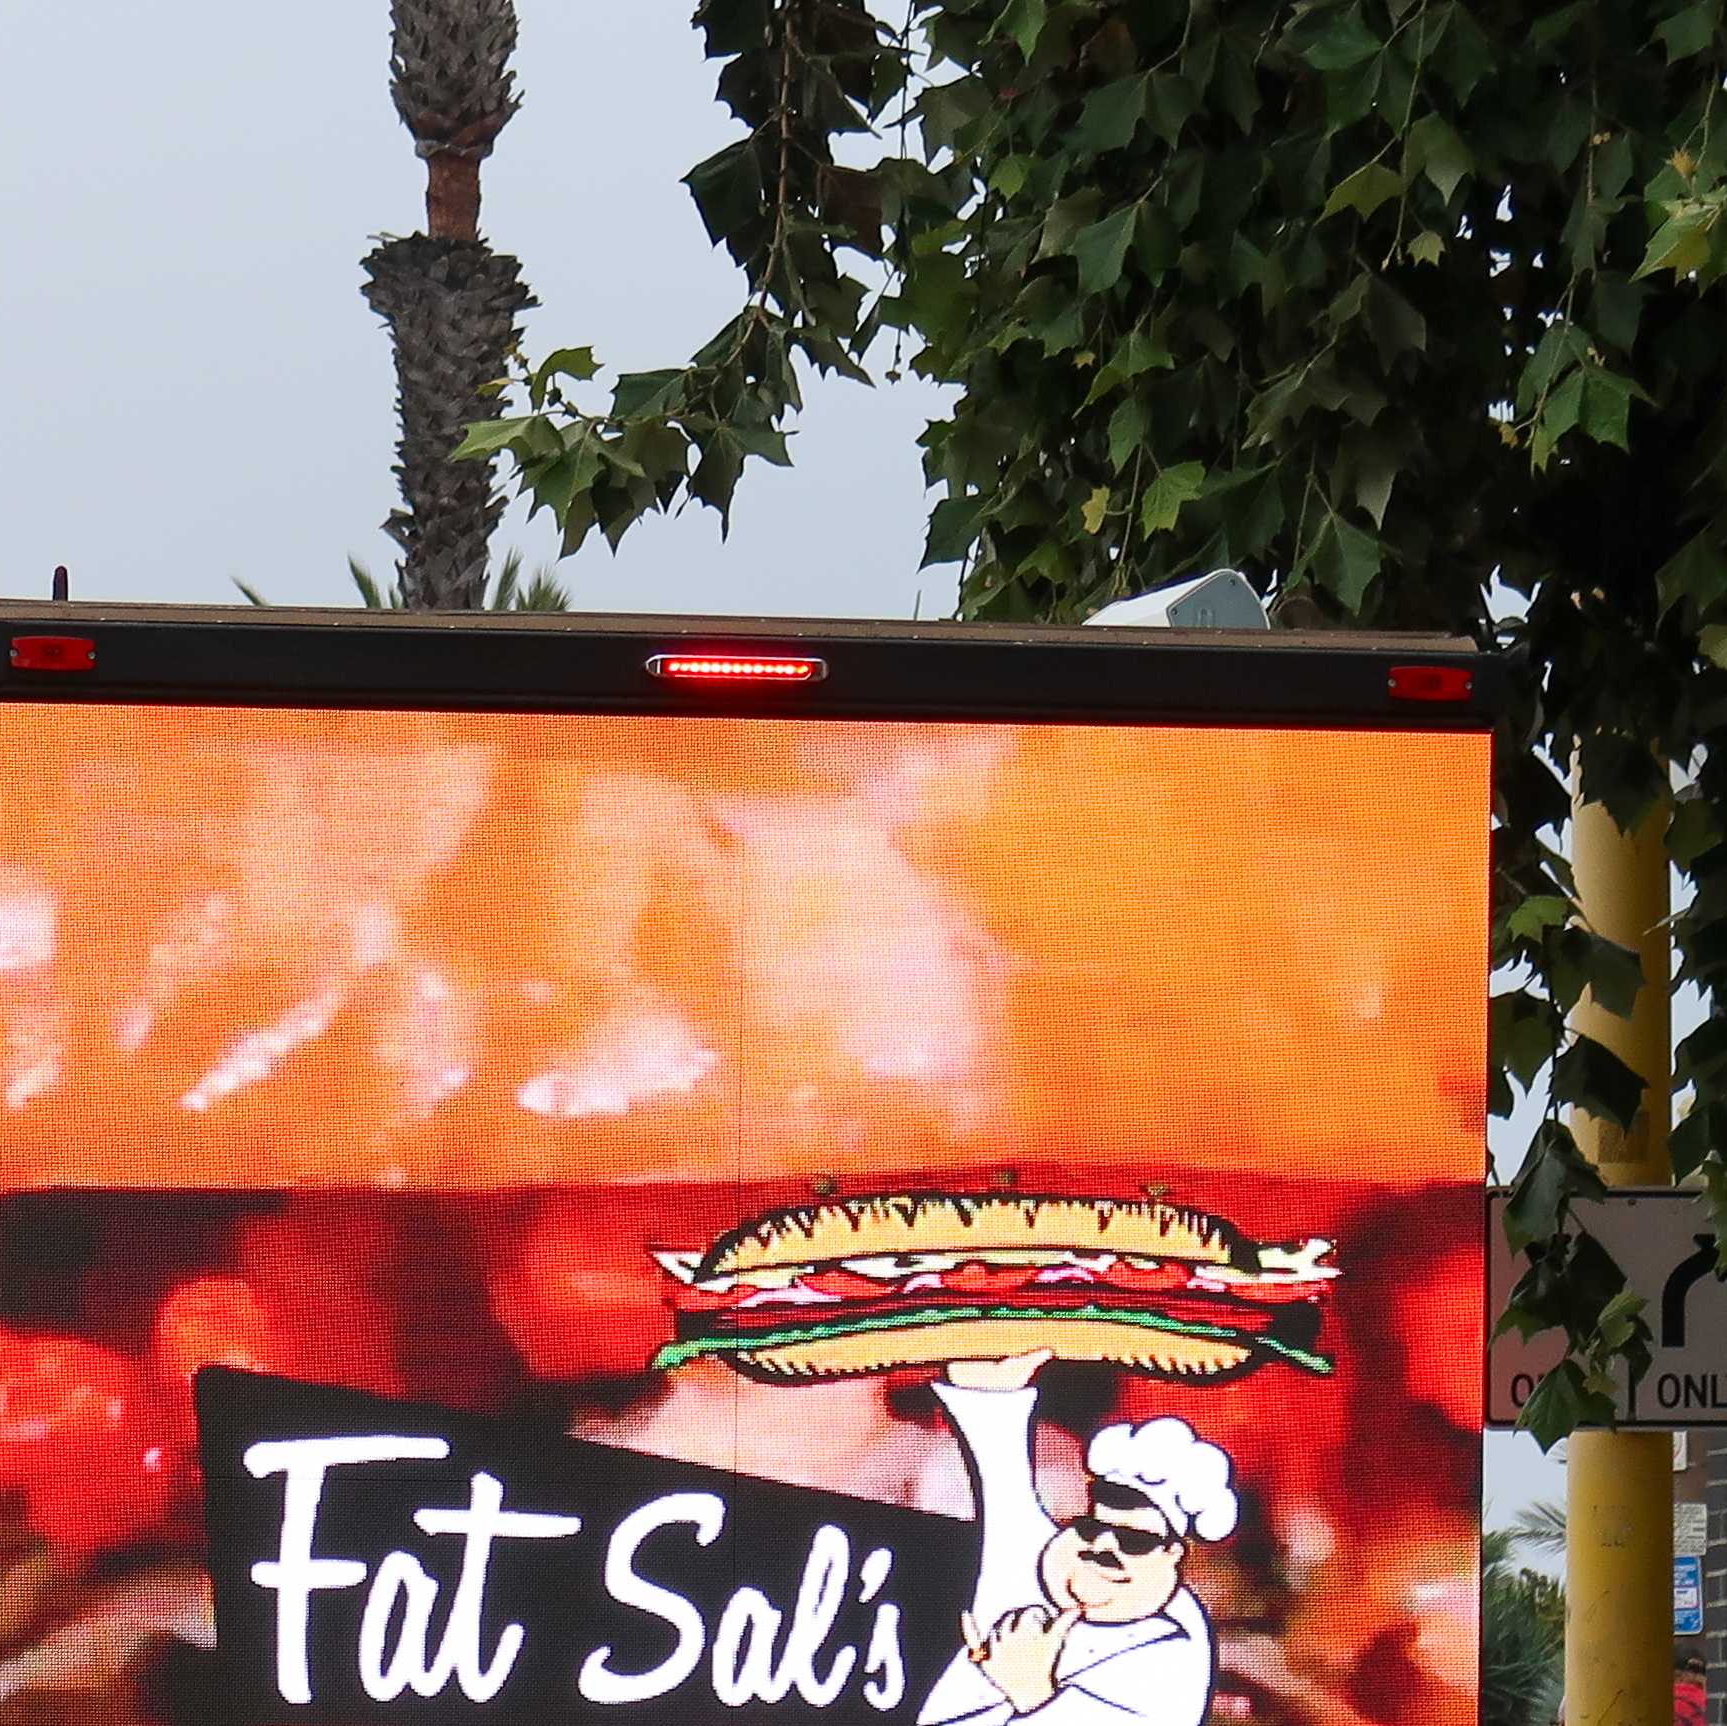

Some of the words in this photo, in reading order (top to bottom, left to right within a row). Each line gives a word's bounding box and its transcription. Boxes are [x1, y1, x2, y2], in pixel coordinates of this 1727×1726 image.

[1657, 1373, 1727, 1409] ONL
[242, 1434, 581, 1706] Fat
[578, 1492, 907, 1708] Sal's
